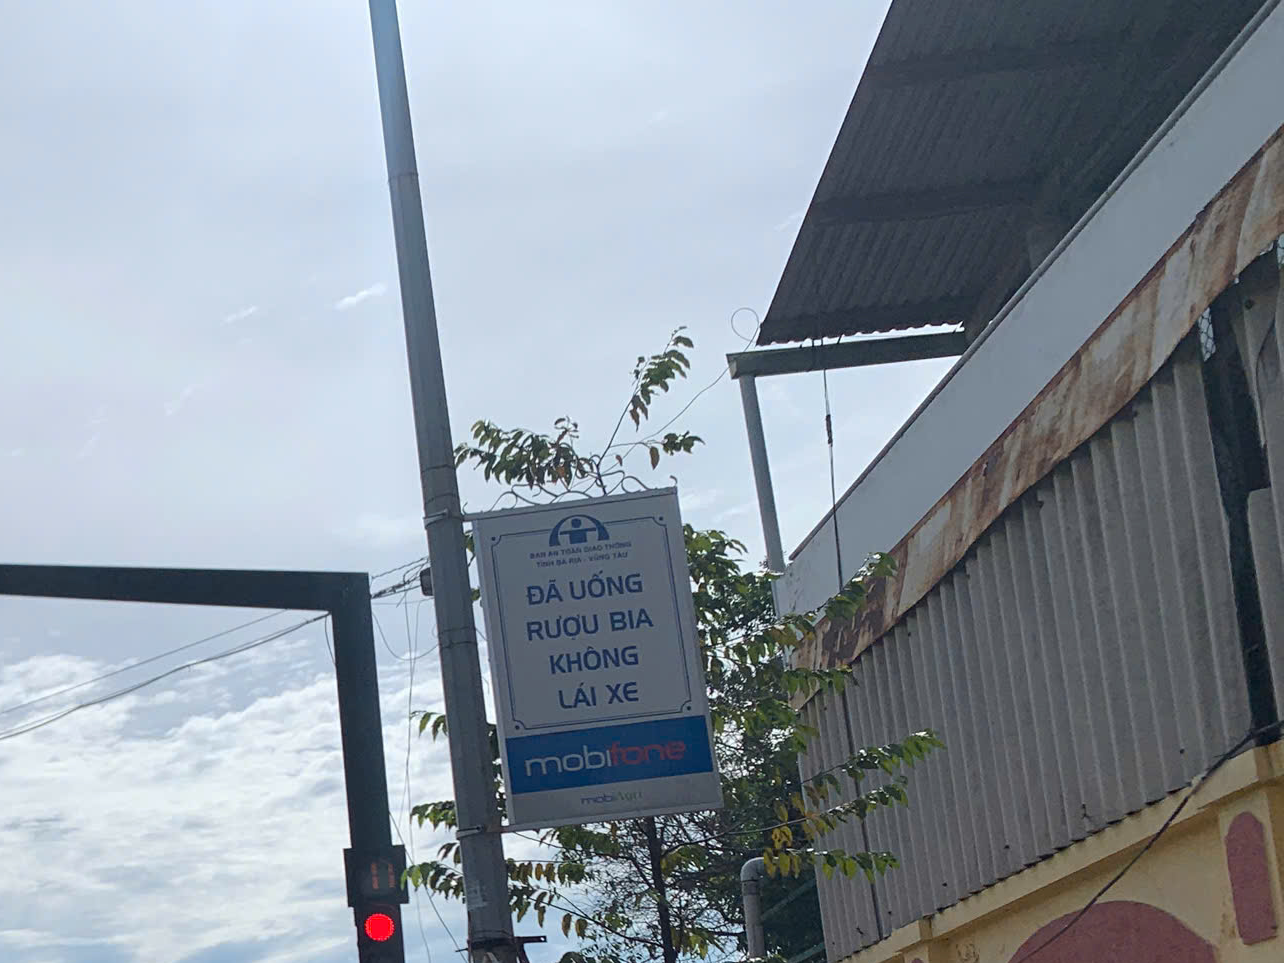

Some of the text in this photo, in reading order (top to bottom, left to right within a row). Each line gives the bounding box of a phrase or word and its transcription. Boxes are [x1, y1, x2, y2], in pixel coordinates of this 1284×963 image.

[525, 570, 644, 606] ĐÃ UỐNG
[526, 607, 654, 641] RƯỢU BIA
[549, 644, 640, 675] KHÔNG
[558, 681, 640, 710] LÁI XE
[524, 740, 688, 778] mobifone
